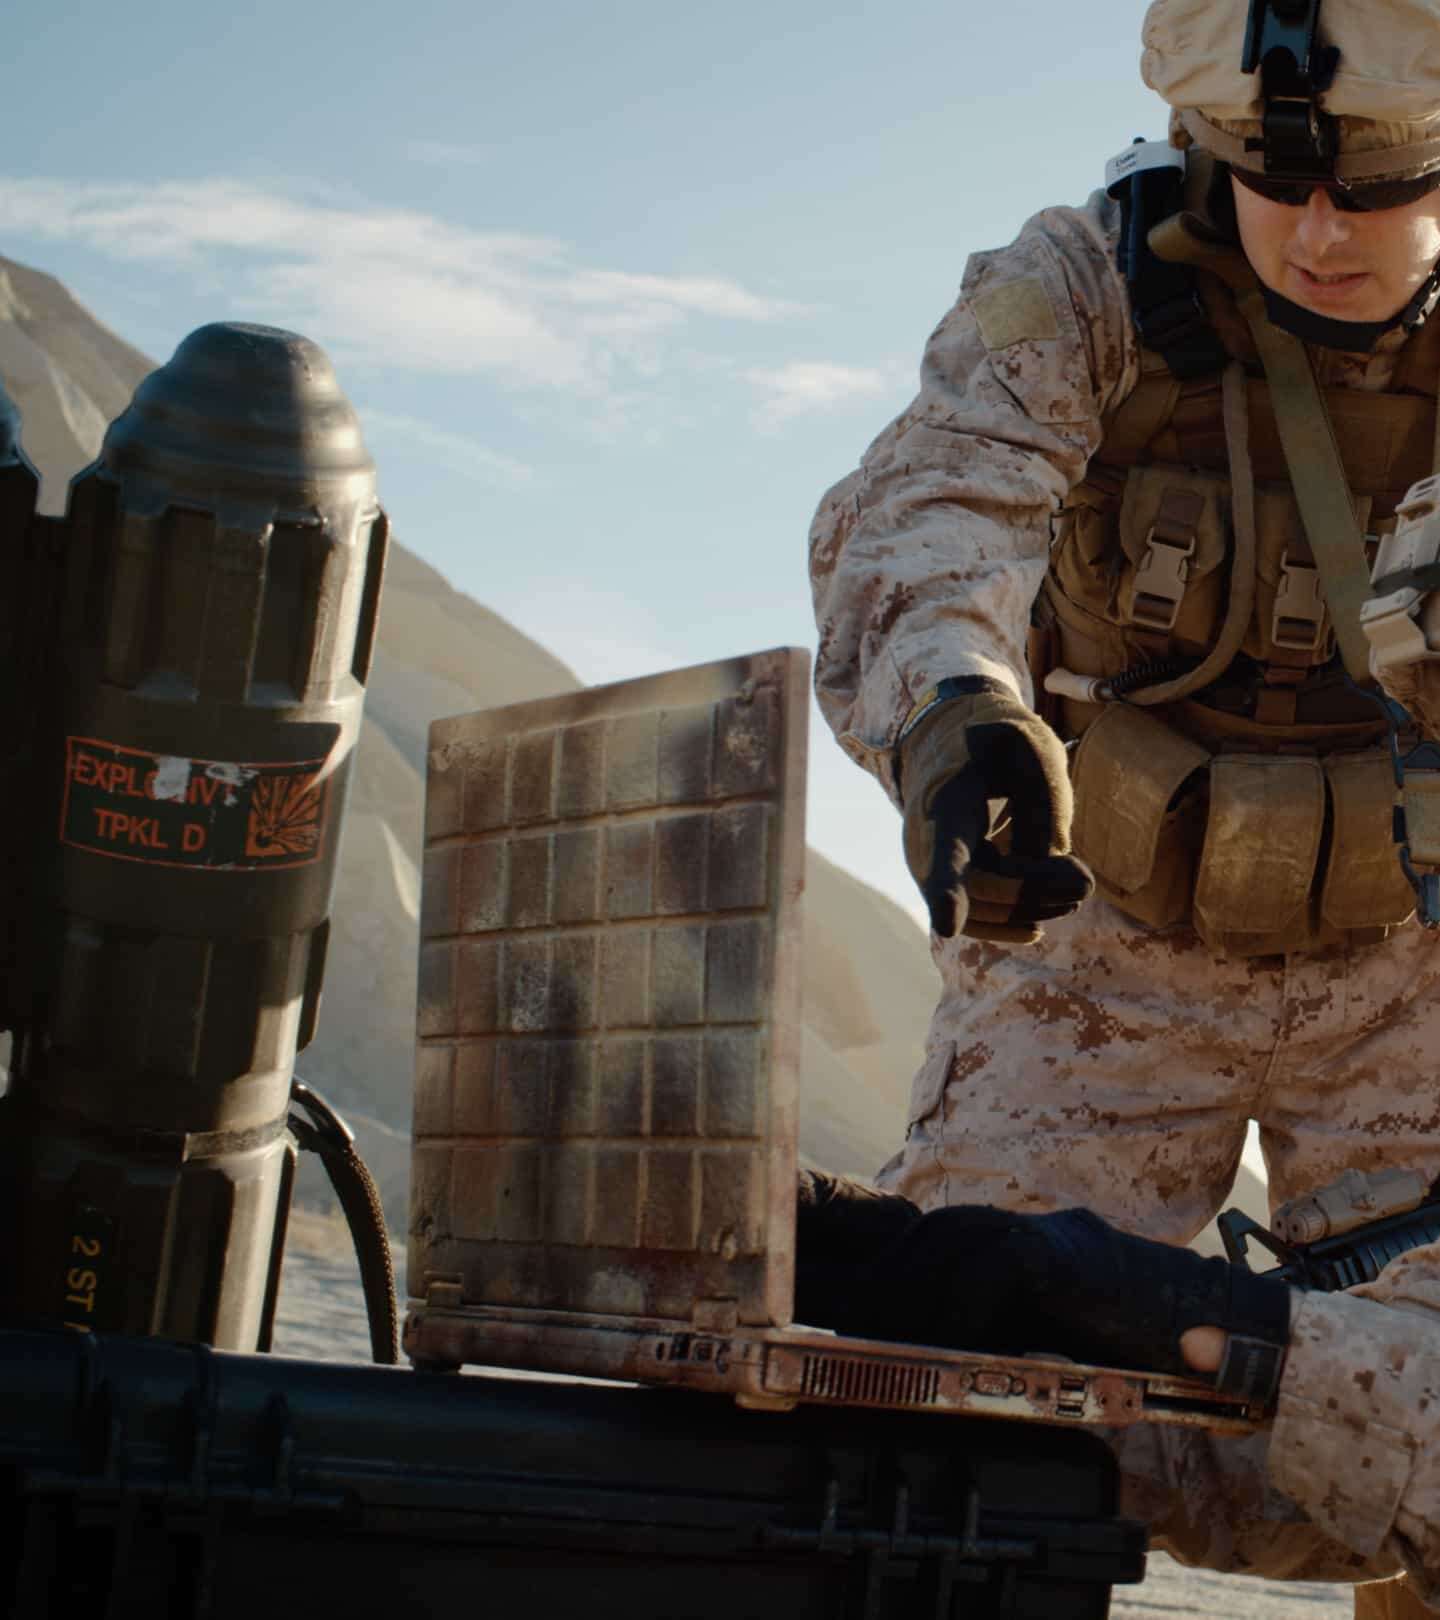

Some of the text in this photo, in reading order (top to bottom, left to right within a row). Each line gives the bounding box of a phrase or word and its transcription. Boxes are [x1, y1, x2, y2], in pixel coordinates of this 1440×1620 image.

[74, 752, 237, 805] EXPLIV
[94, 808, 206, 851] TPKL D
[72, 1235, 103, 1257] 2
[65, 1268, 97, 1312] ST
